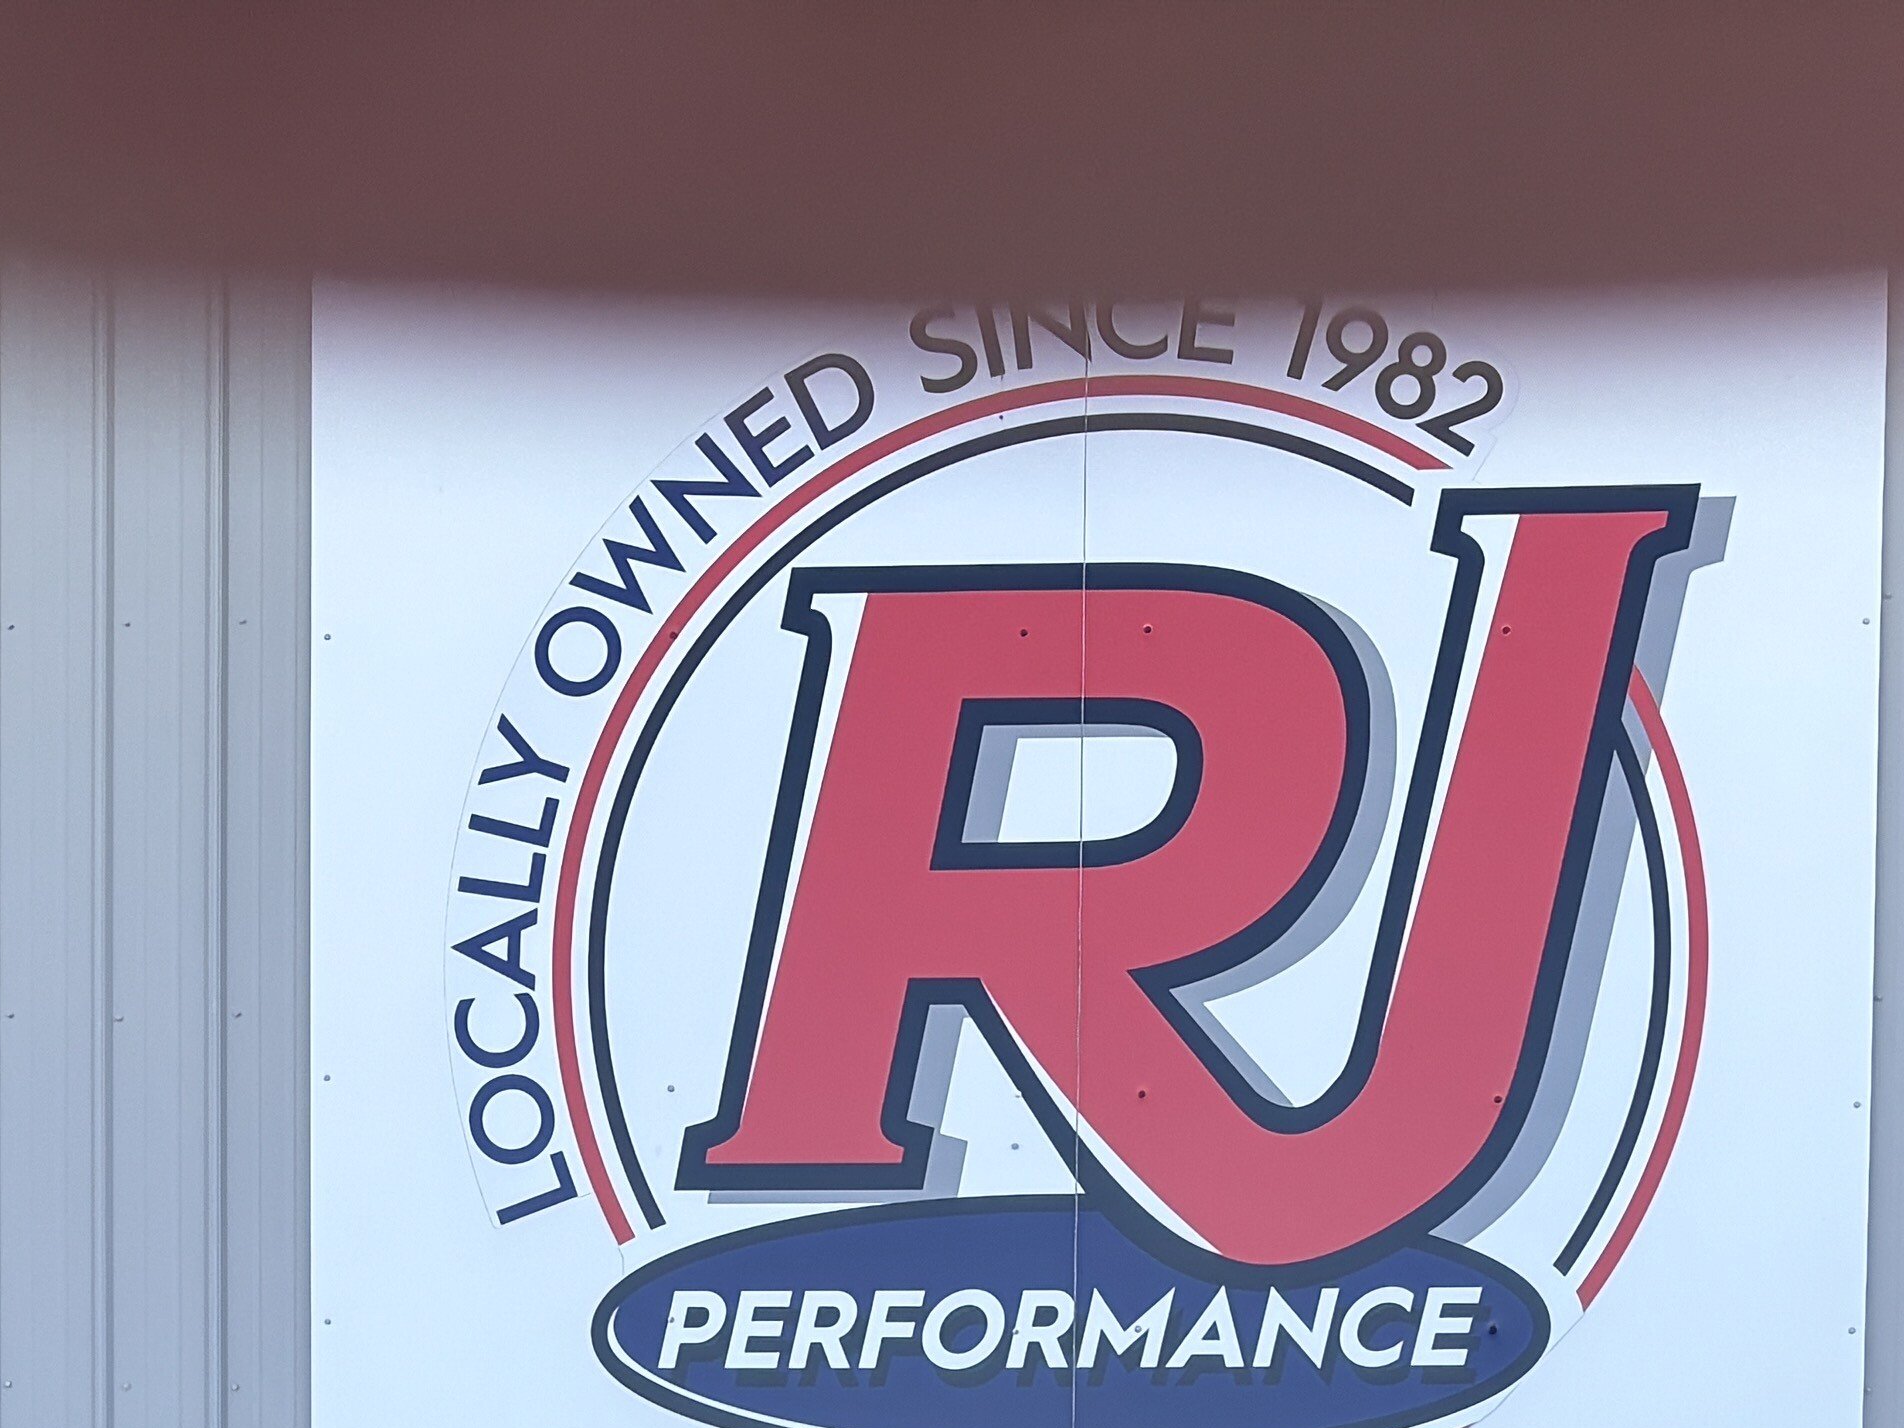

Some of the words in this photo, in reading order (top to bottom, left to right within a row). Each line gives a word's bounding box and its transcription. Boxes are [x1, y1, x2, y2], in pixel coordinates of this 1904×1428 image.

[450, 713, 580, 1225] LOCALLY
[533, 351, 877, 697] OWNED
[908, 296, 1238, 393] SINCE
[1287, 298, 1505, 457] 1982
[674, 482, 1702, 1284] RJ
[656, 1284, 1483, 1372] PERFORMANCE
